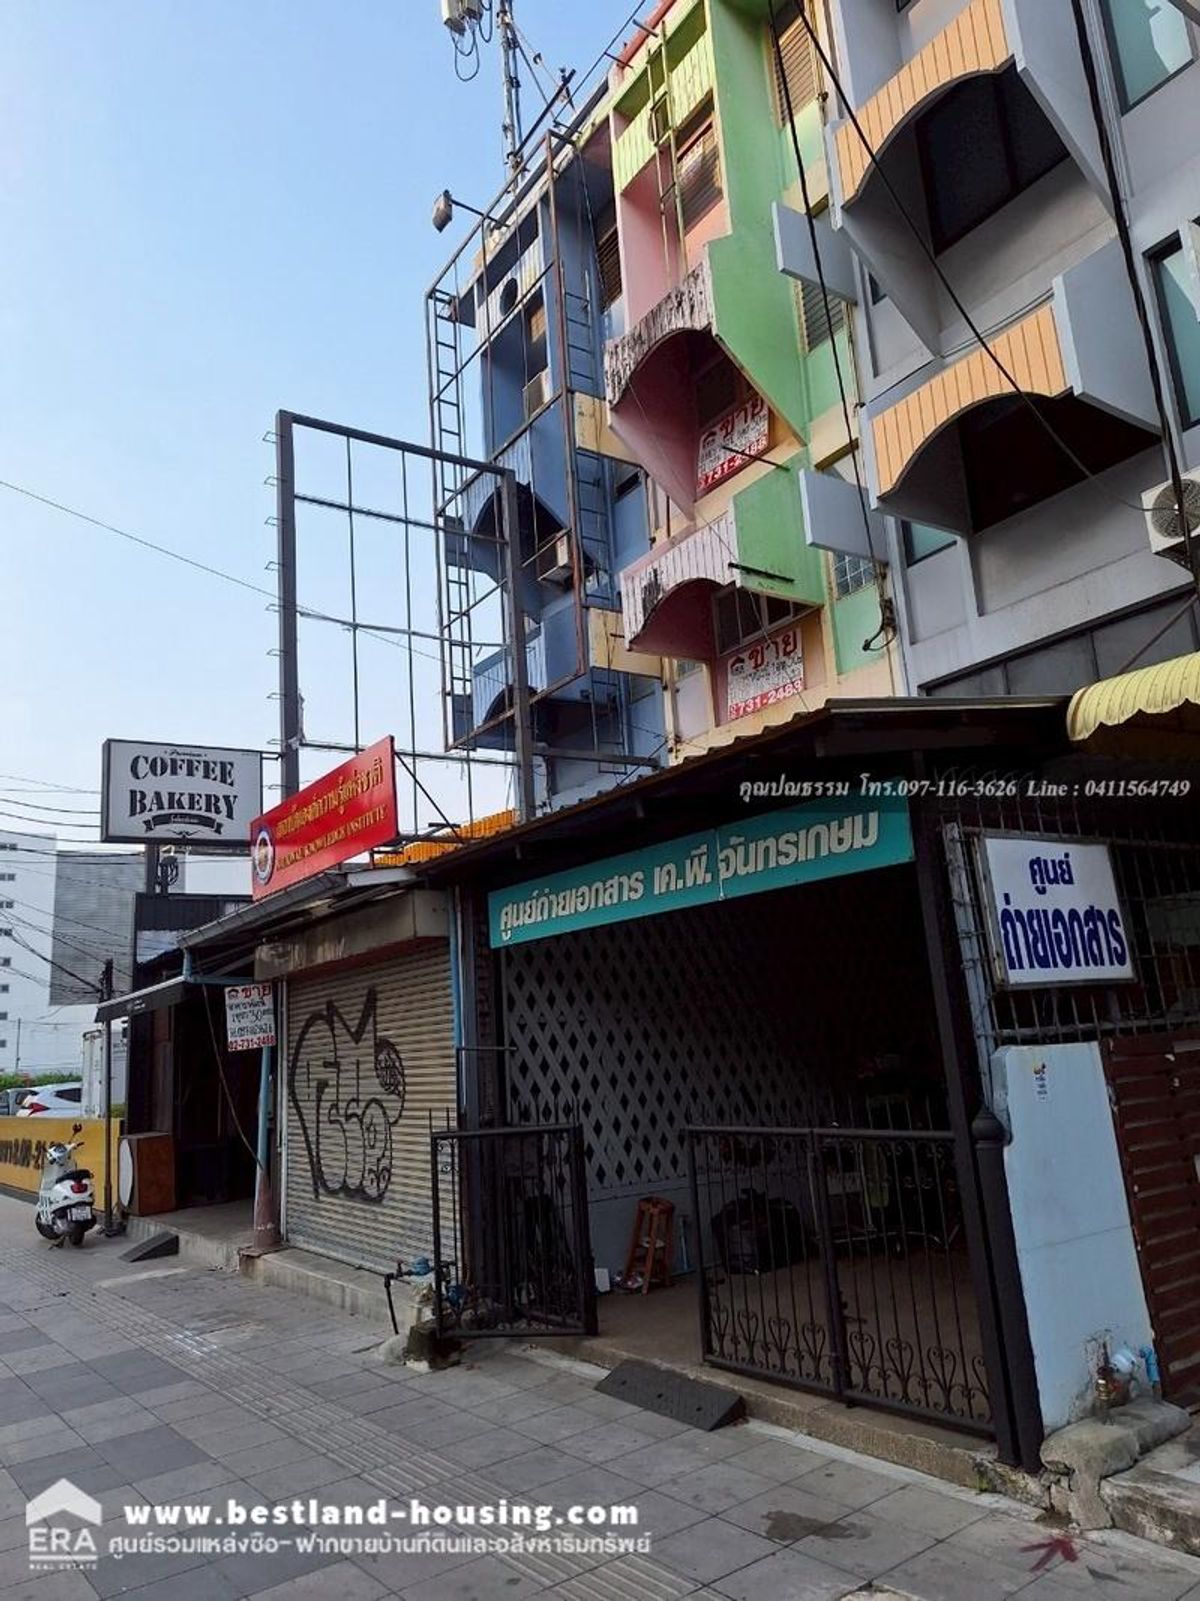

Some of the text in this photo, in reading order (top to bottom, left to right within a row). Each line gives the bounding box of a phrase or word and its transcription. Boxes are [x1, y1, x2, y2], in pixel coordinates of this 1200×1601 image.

[719, 396, 765, 441] ขาย
[748, 630, 798, 670] ขาย
[130, 754, 235, 787] COFFEE
[128, 789, 239, 821] BAKERY
[499, 811, 880, 942] ศูนย์ถ่ายเอกสาร เค.พี. จันทรเกษม
[1029, 852, 1076, 895] ศูนย์
[1000, 892, 1128, 971] ถ่ายเอกสาร
